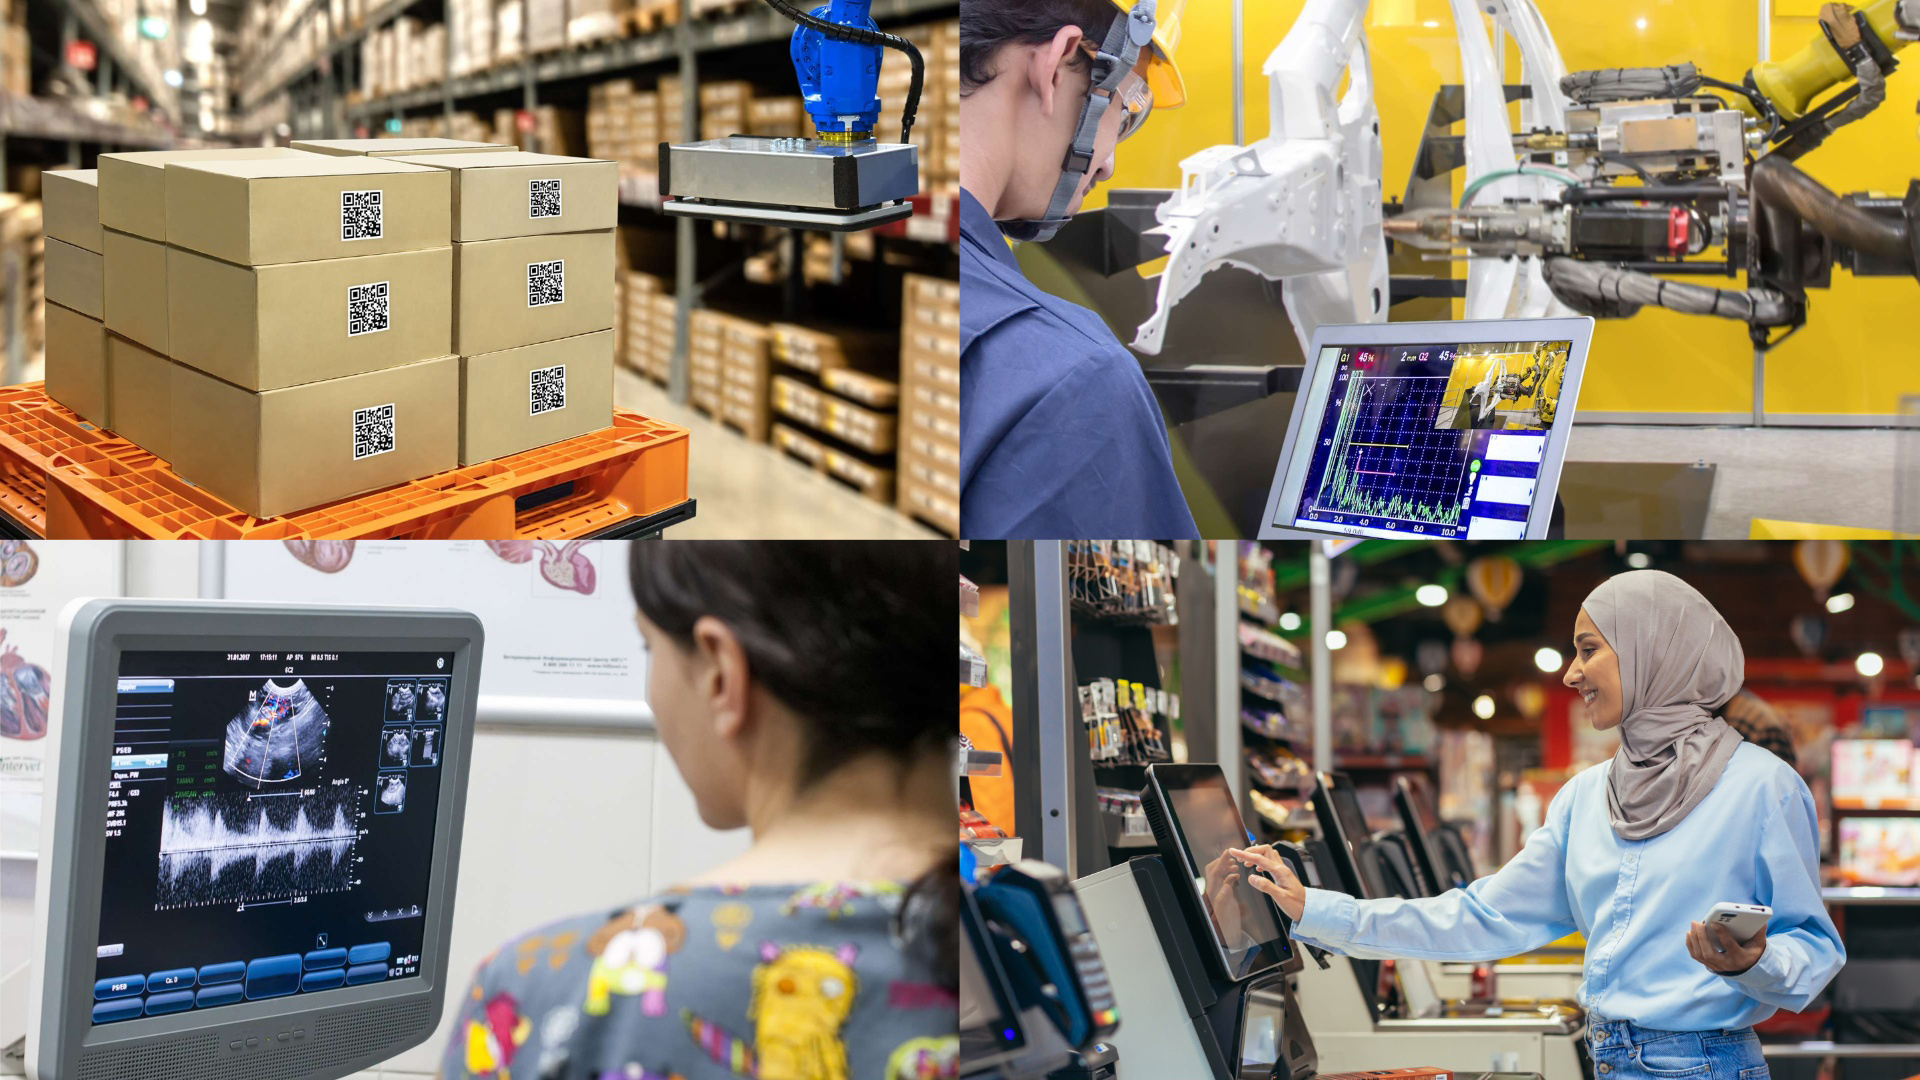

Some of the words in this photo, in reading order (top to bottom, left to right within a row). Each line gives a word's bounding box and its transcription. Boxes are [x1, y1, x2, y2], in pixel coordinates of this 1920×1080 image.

[1340, 354, 1350, 362] G1
[1418, 352, 1430, 361] G2
[1441, 528, 1456, 536] 10.0
